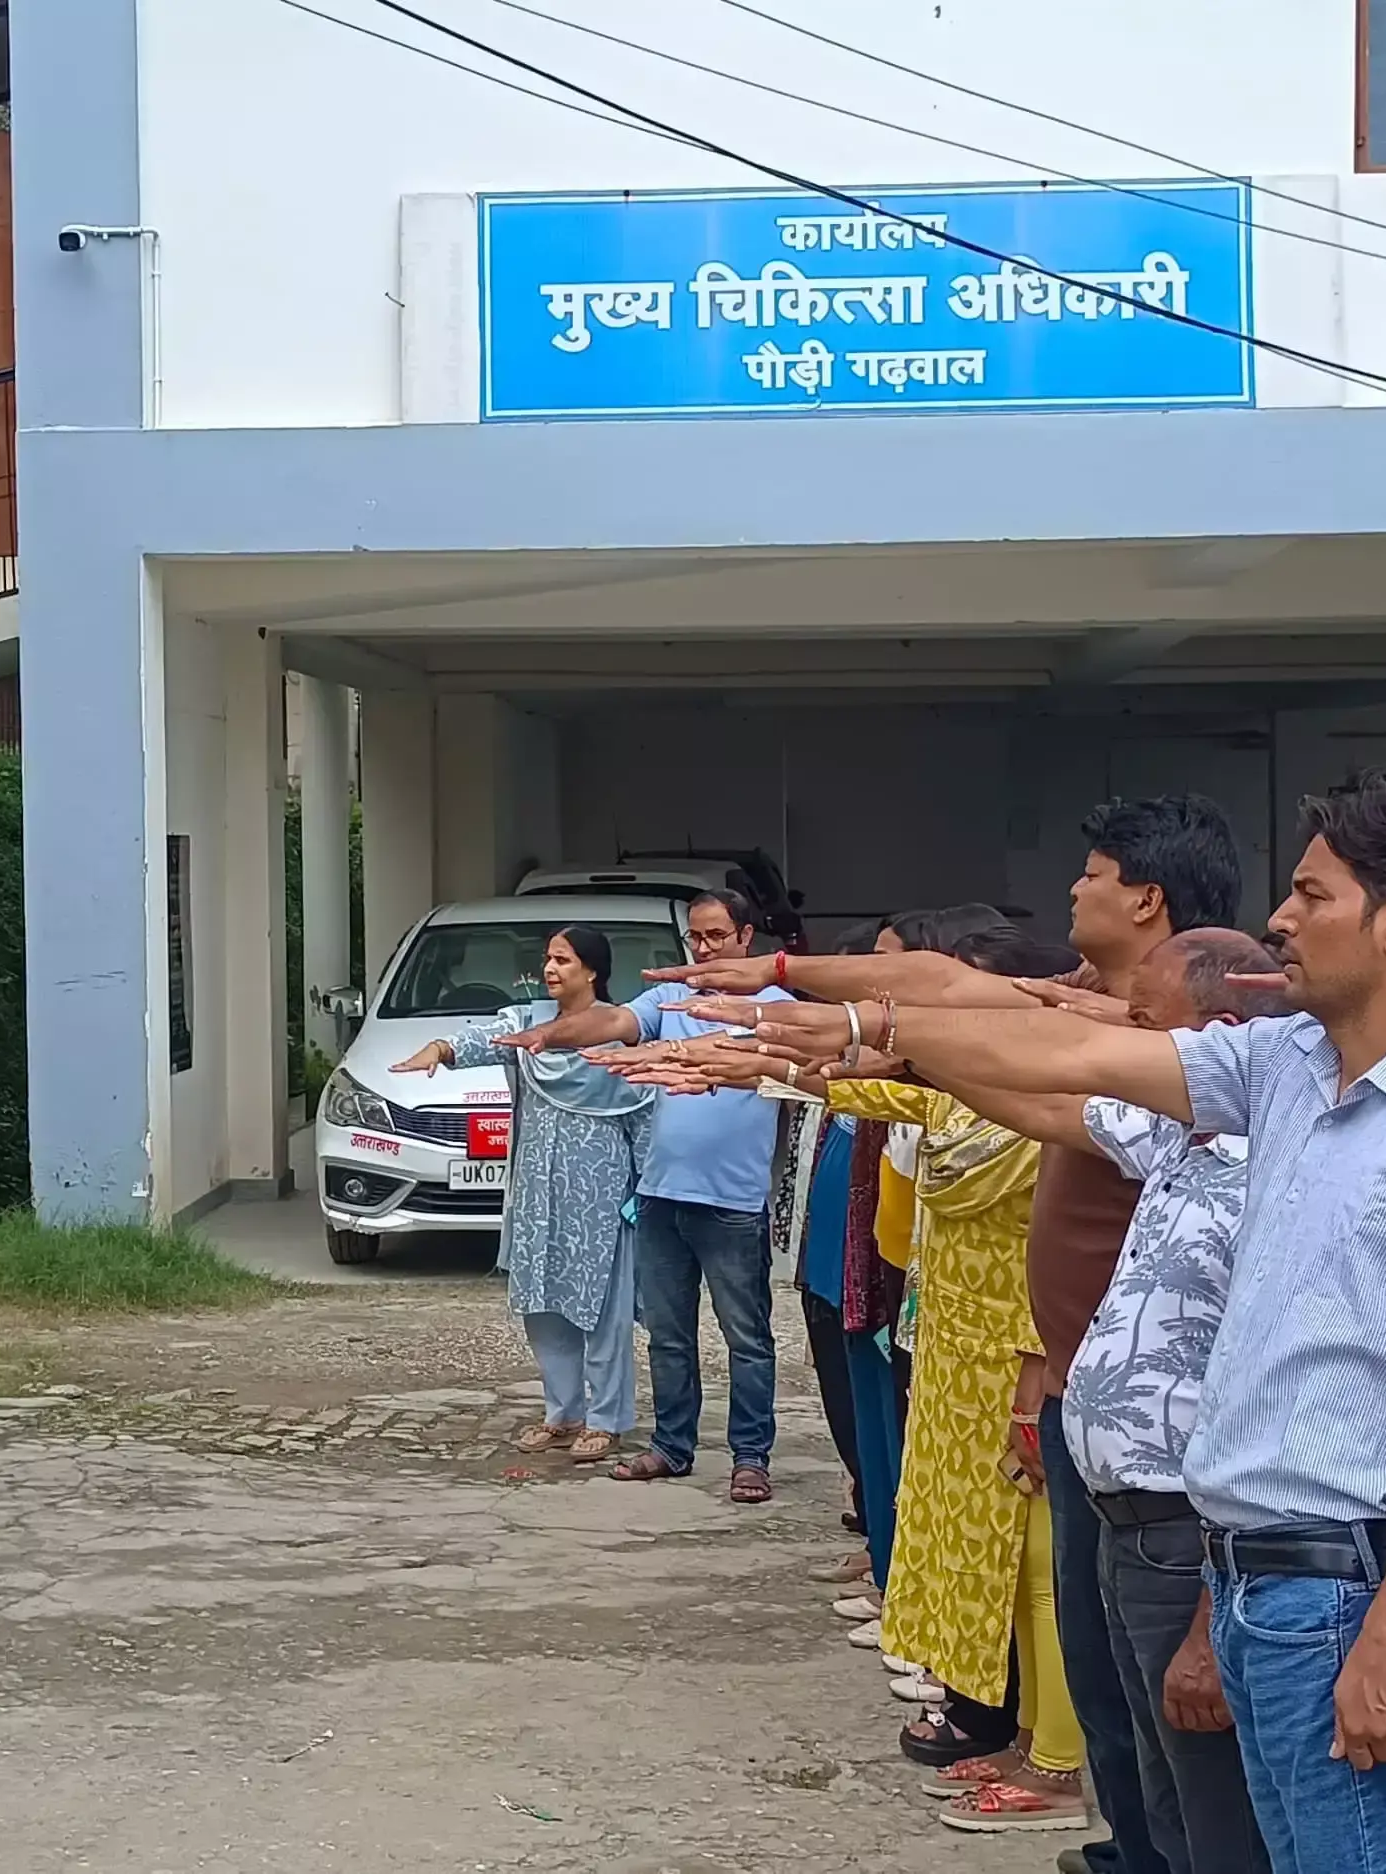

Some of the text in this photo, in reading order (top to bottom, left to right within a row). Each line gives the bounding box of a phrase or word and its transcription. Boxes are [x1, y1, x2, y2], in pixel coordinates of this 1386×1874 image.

[776, 200, 949, 251] कार्यालय
[539, 250, 1191, 353] मुख्य चिकित्सा अधिकारी
[741, 338, 987, 395] पौड़ी गढ़वाल
[350, 1132, 402, 1157] उत्तराखण्ड
